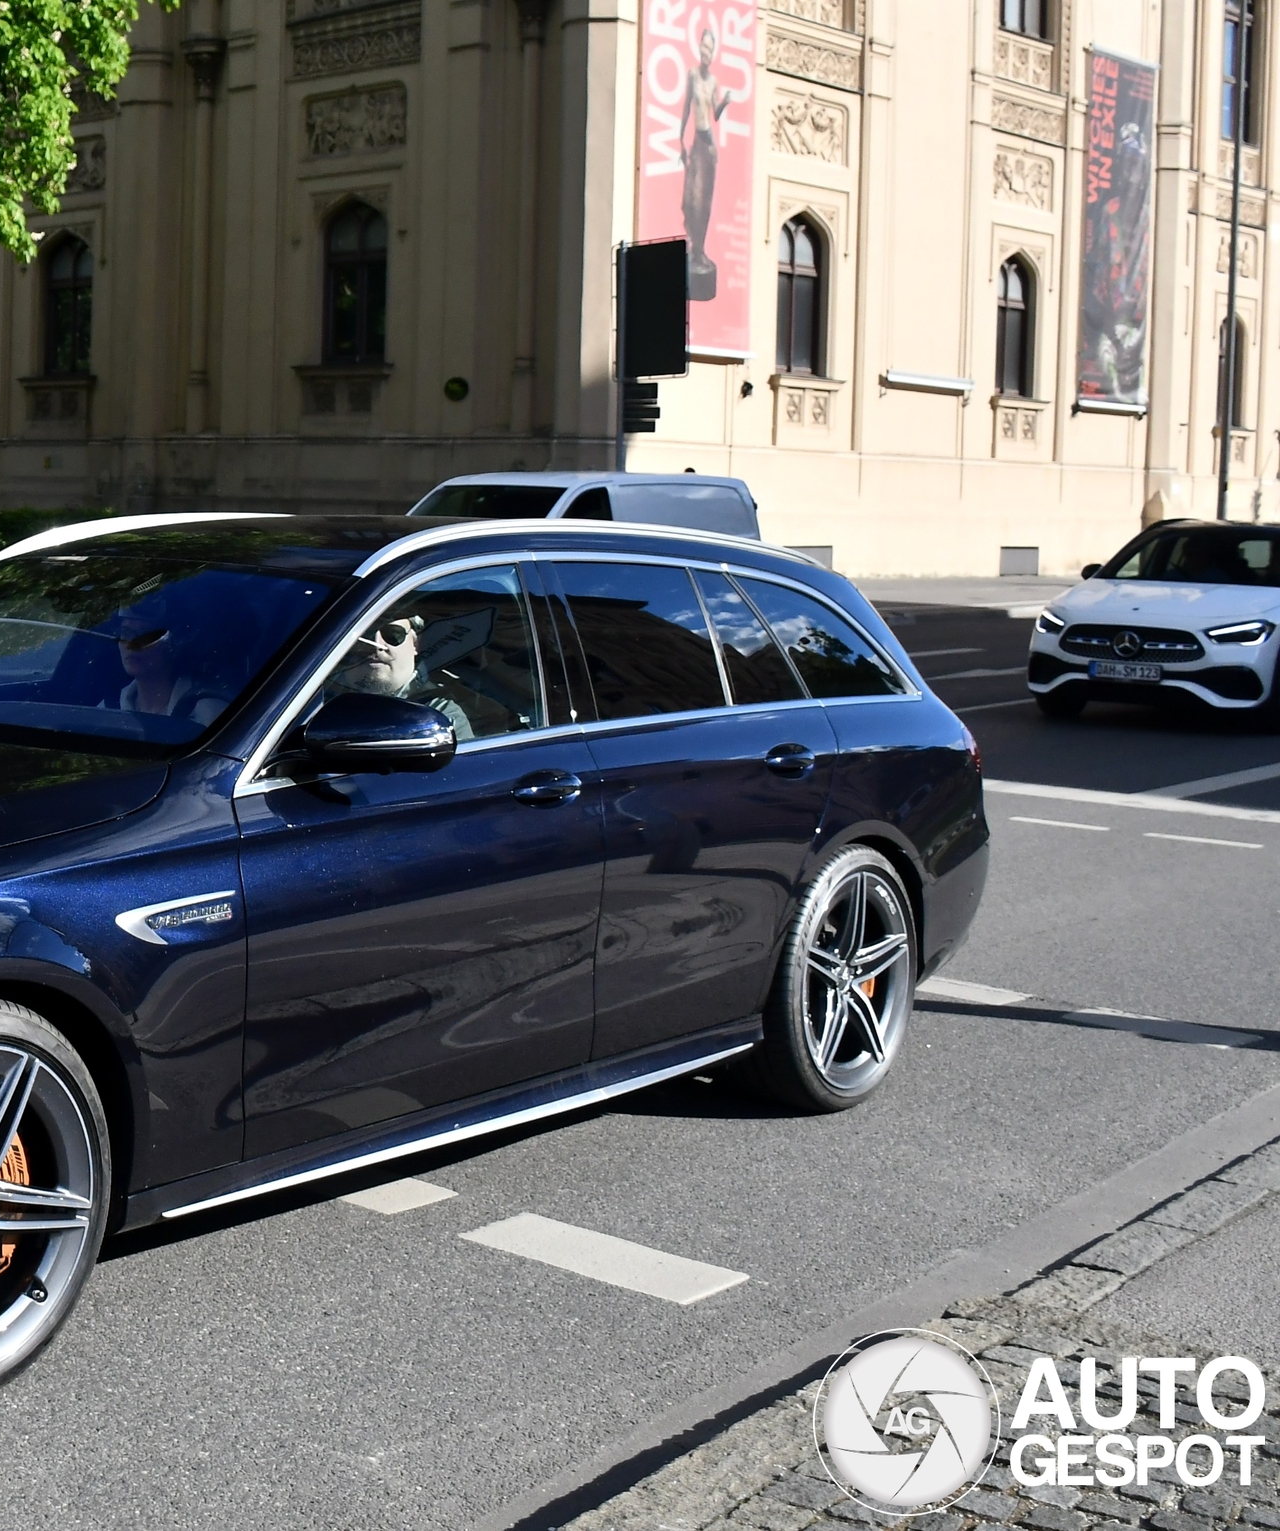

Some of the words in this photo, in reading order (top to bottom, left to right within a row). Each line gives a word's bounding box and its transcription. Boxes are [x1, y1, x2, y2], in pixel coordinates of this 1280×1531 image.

[719, 0, 754, 148] TUR
[1100, 58, 1120, 150] EXILE
[1087, 55, 1106, 204] WITCHES
[1098, 155, 1113, 189] IN
[1096, 663, 1116, 676] DAH
[1123, 665, 1137, 677] SM
[1139, 667, 1159, 679] 123
